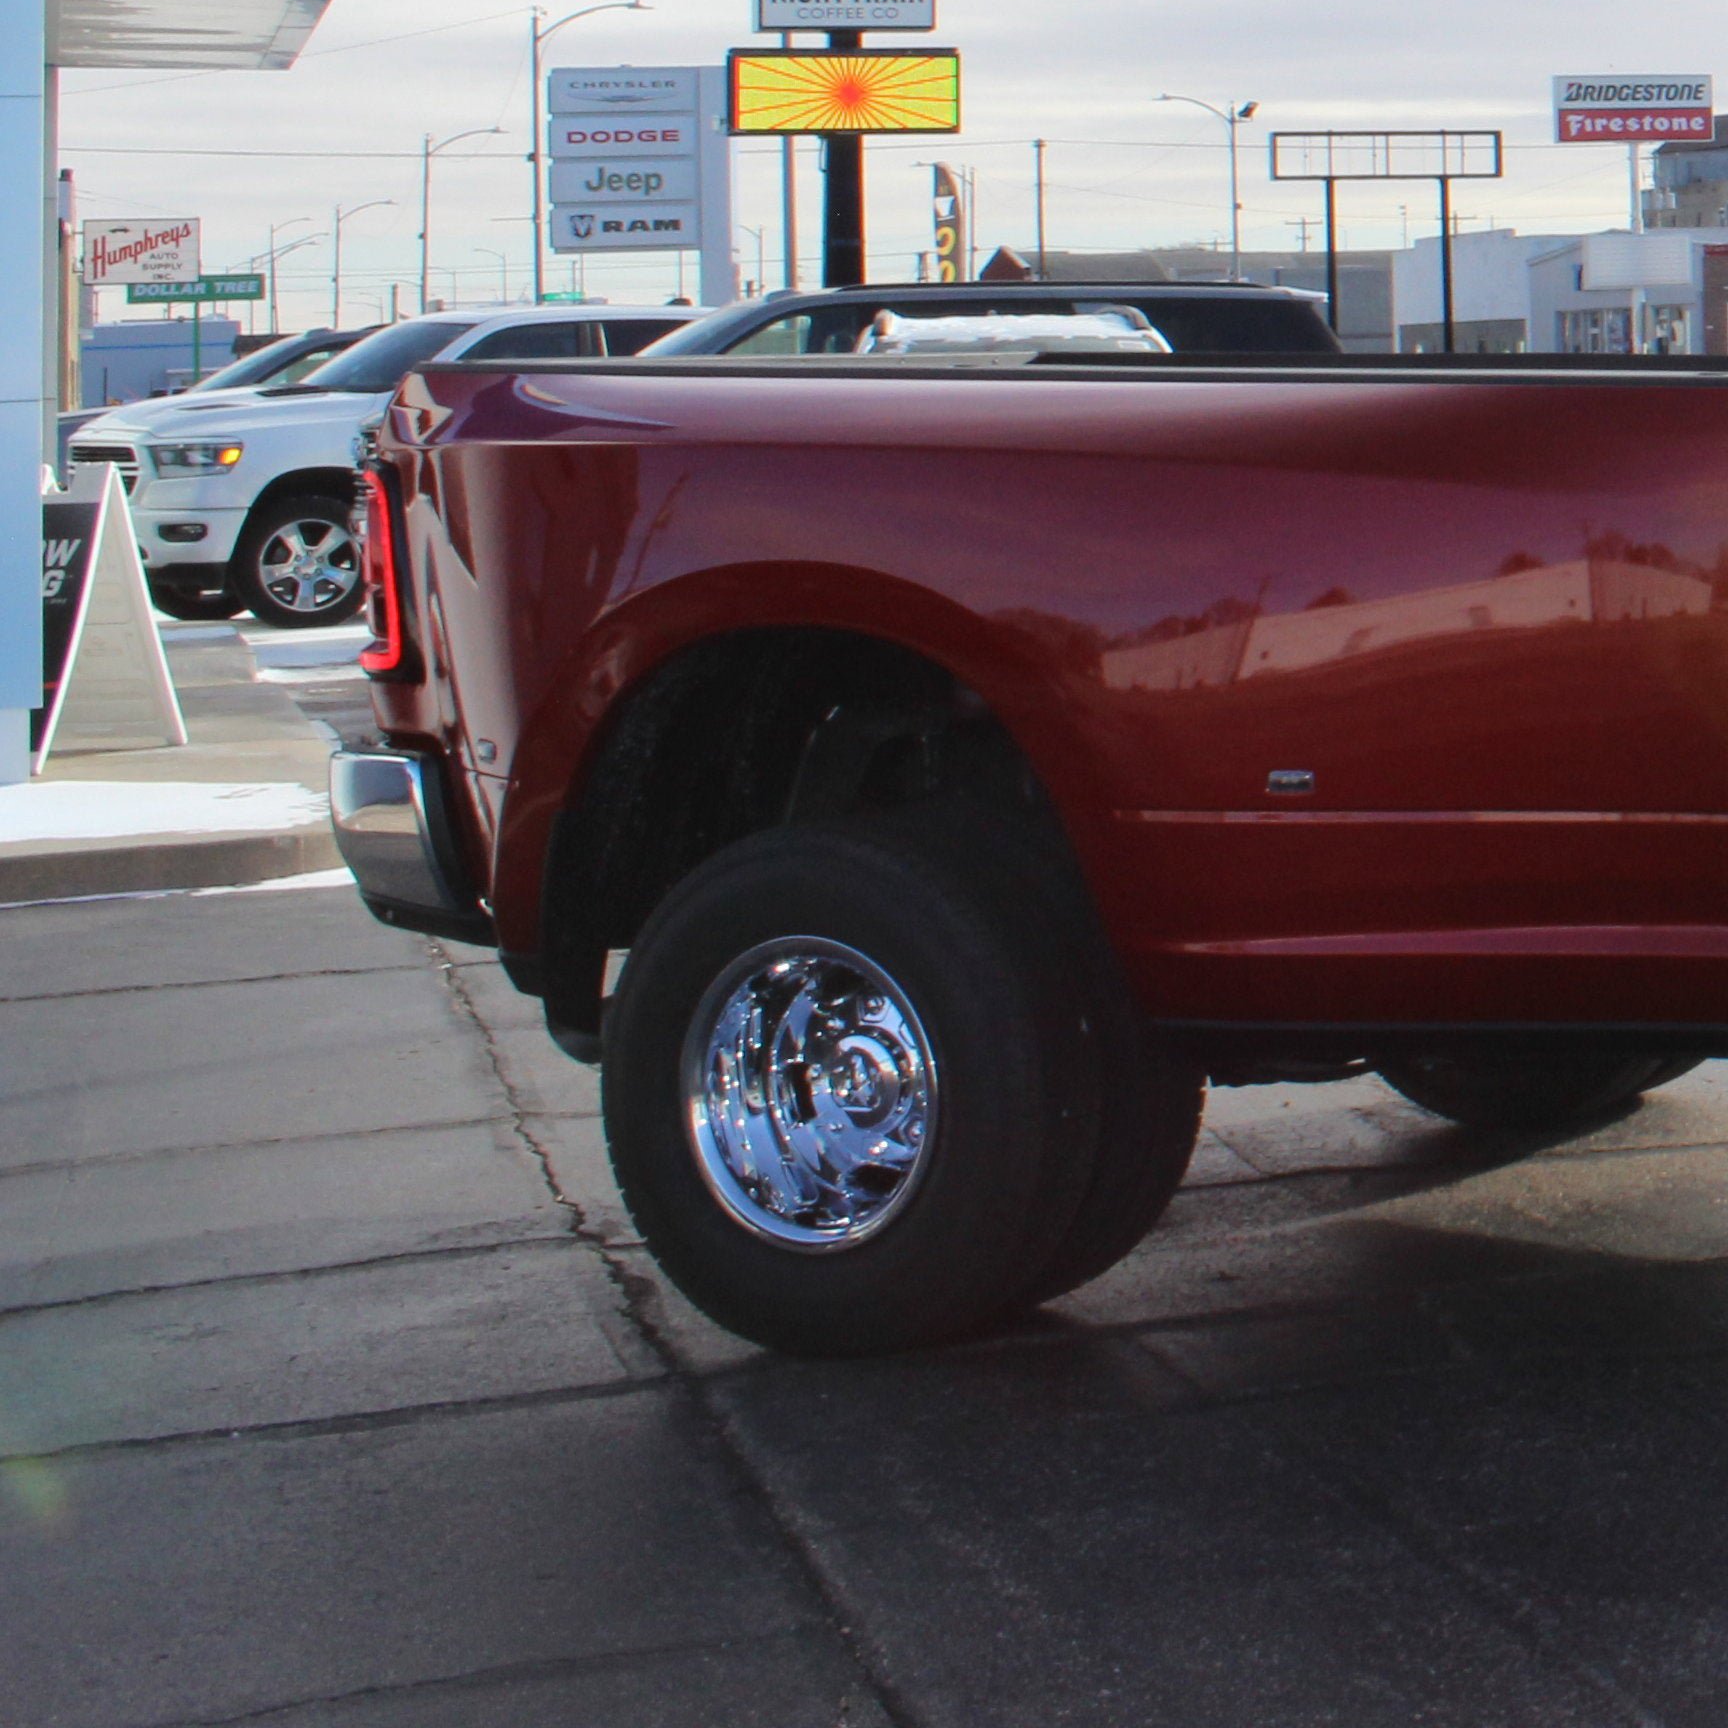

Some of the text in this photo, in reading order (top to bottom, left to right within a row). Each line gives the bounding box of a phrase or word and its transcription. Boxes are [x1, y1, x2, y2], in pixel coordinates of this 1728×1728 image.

[797, 7, 899, 19] COFFEE CO
[569, 80, 677, 89] CHRYSLER
[1564, 82, 1706, 102] BRIDGESTONE
[1566, 114, 1705, 137] Firestone
[566, 129, 680, 144] DODGE
[585, 167, 664, 196] Jeep
[602, 219, 682, 233] RAM
[91, 223, 192, 280] Humphreys
[149, 252, 179, 260] AUTO
[134, 280, 259, 297] DOLLAR TREE
